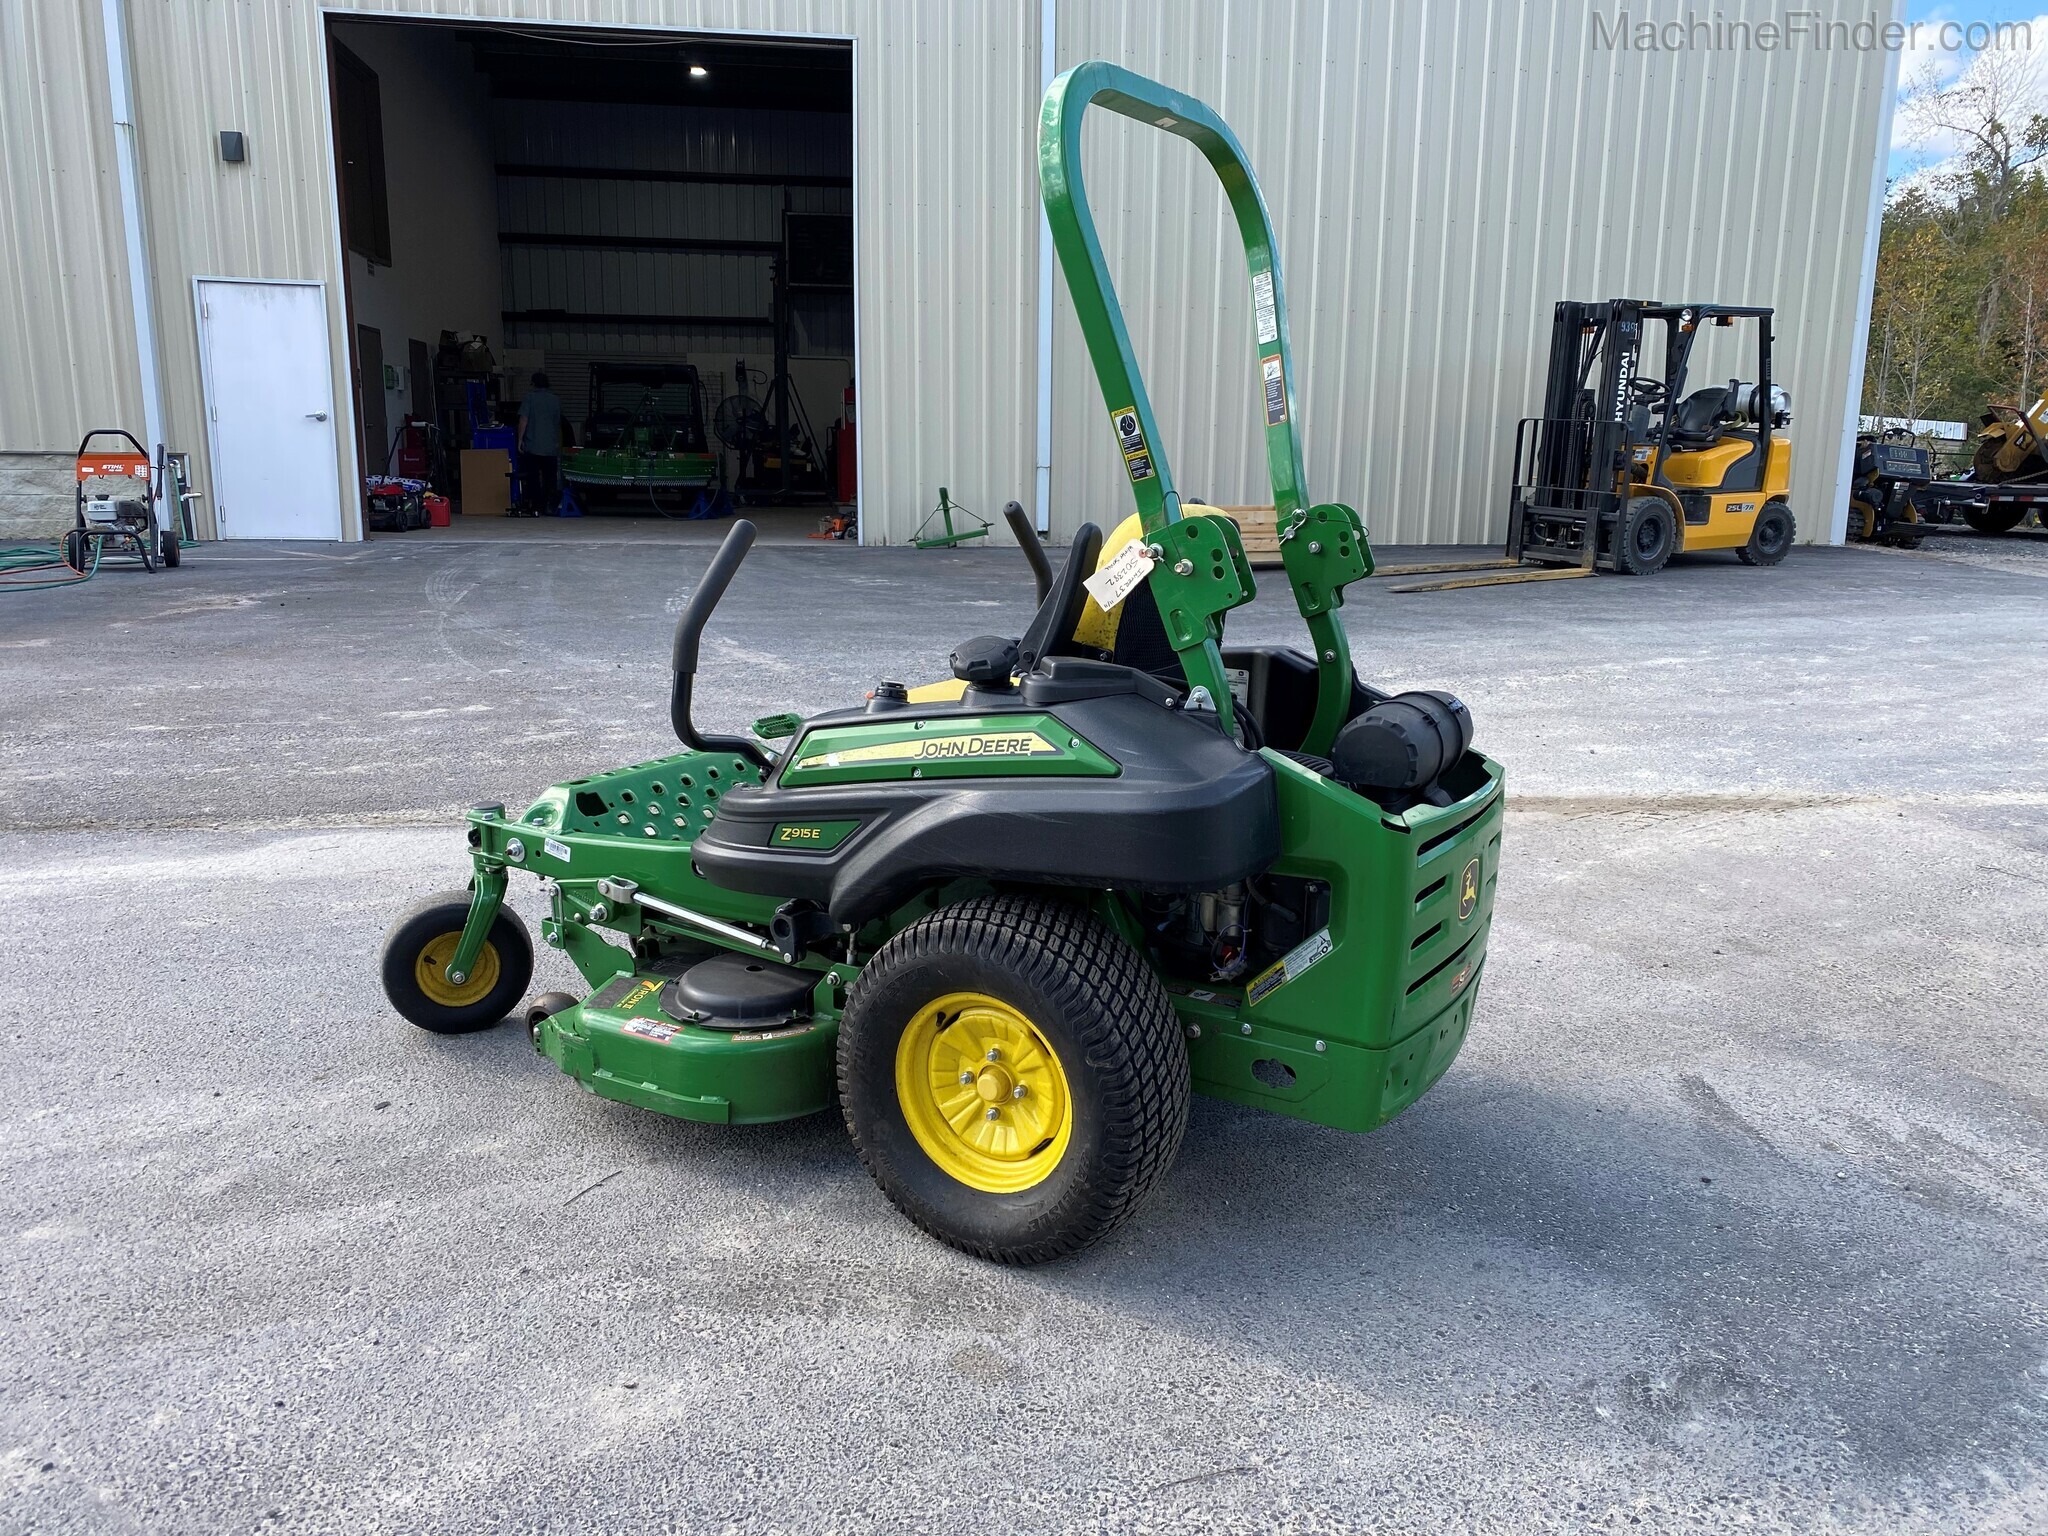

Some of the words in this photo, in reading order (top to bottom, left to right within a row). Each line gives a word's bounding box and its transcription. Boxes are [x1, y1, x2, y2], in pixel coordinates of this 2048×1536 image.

[1615, 352, 1629, 421] HYUNDAI
[915, 740, 965, 757] JOHN
[968, 738, 1033, 756] DEERE
[781, 828, 820, 840] Z915E
